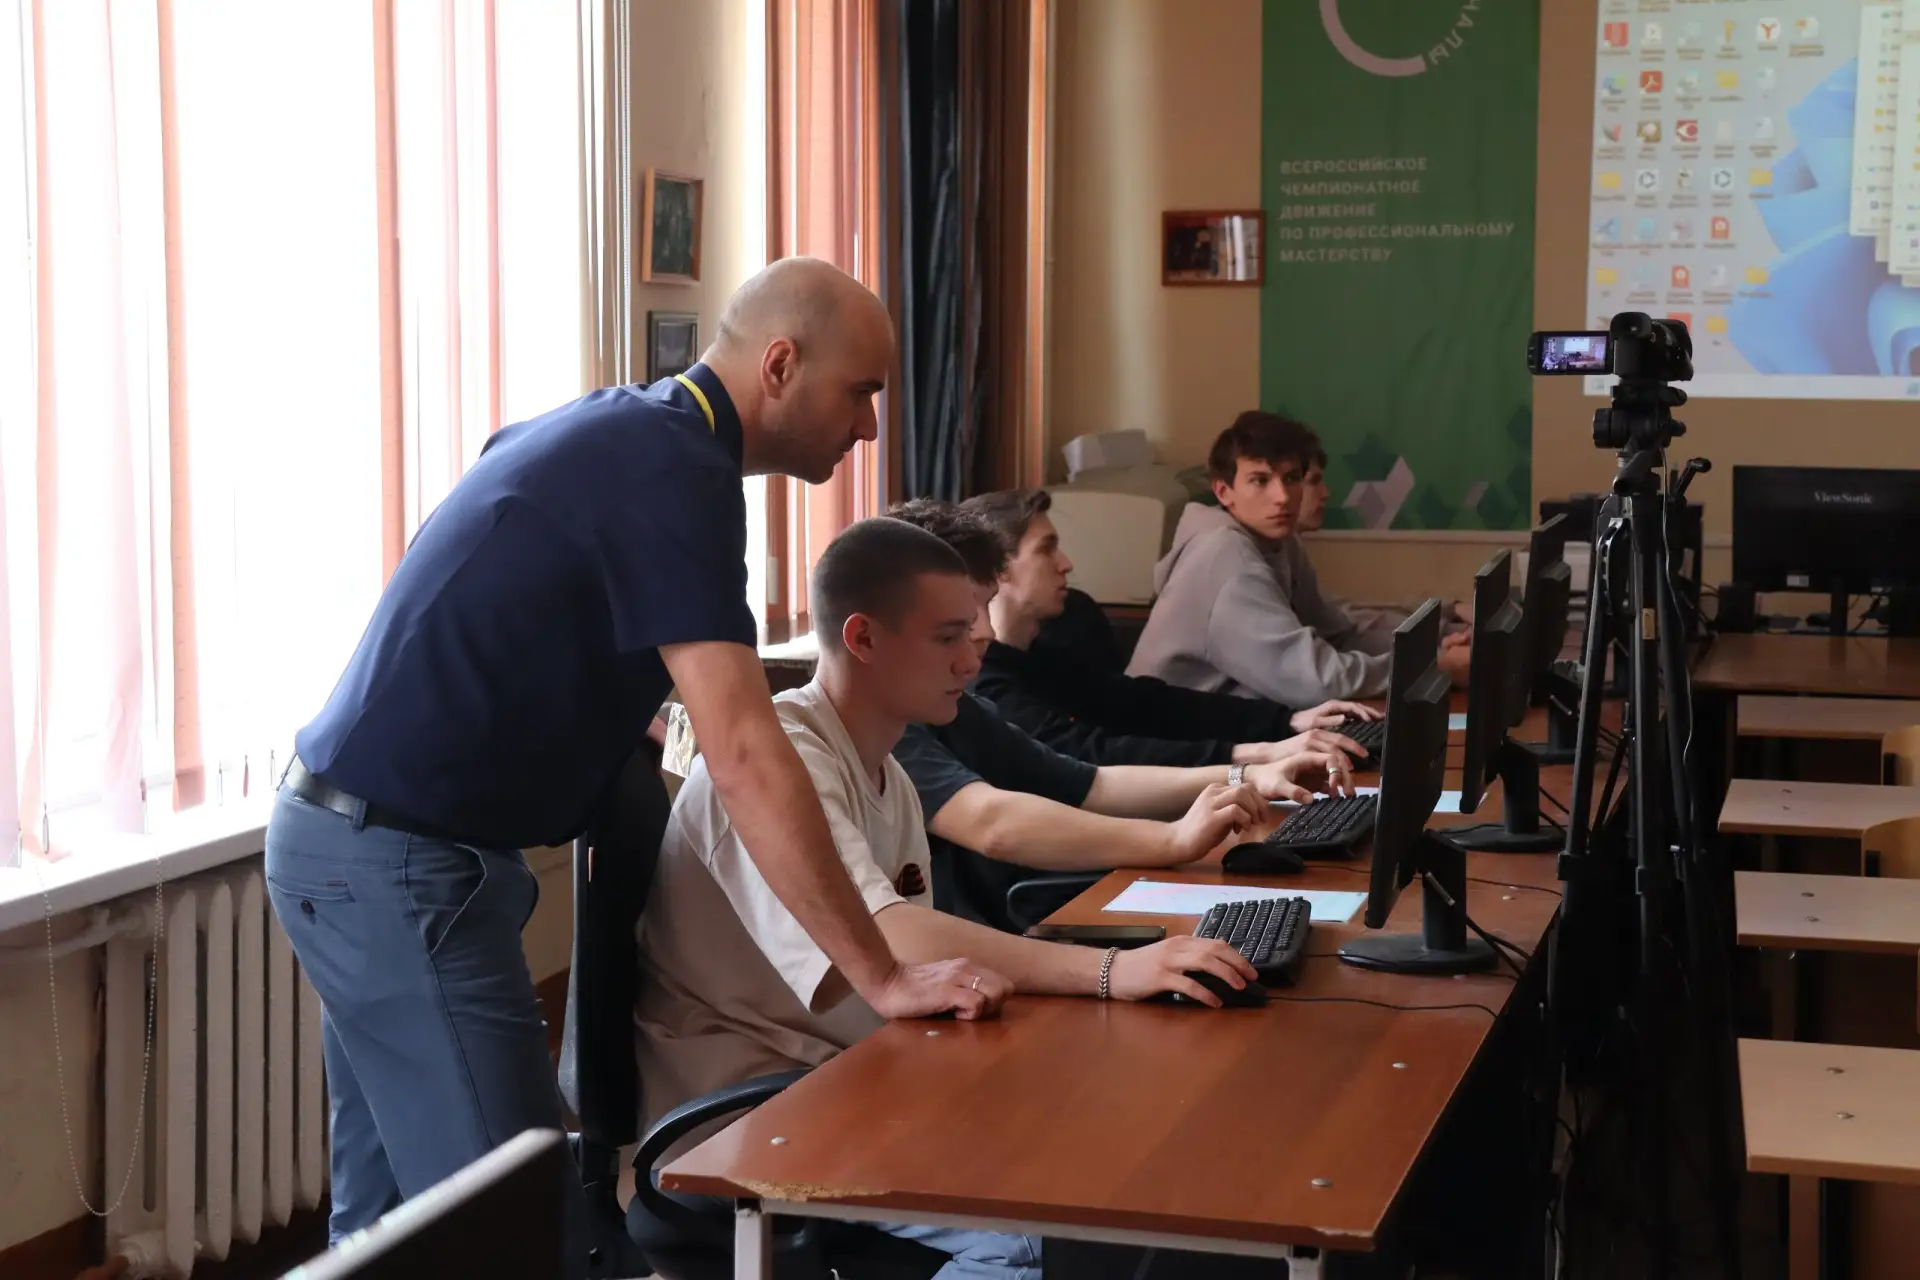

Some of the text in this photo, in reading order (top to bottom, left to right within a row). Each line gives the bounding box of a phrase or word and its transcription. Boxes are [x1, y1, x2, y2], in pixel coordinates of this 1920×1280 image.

[1280, 156, 1428, 175] ВСЕРОССИЙСКОЕ
[1280, 179, 1421, 196] ЧЕМПИОНАТНОЕ
[1279, 203, 1376, 220] ДВИЖЕНИЕ
[1280, 222, 1515, 240] ПО ПРОФЕССИОНАЛЬНОМУ
[1279, 248, 1393, 262] МАСТЕРСТВУ
[1814, 490, 1873, 505] ViewSonic
